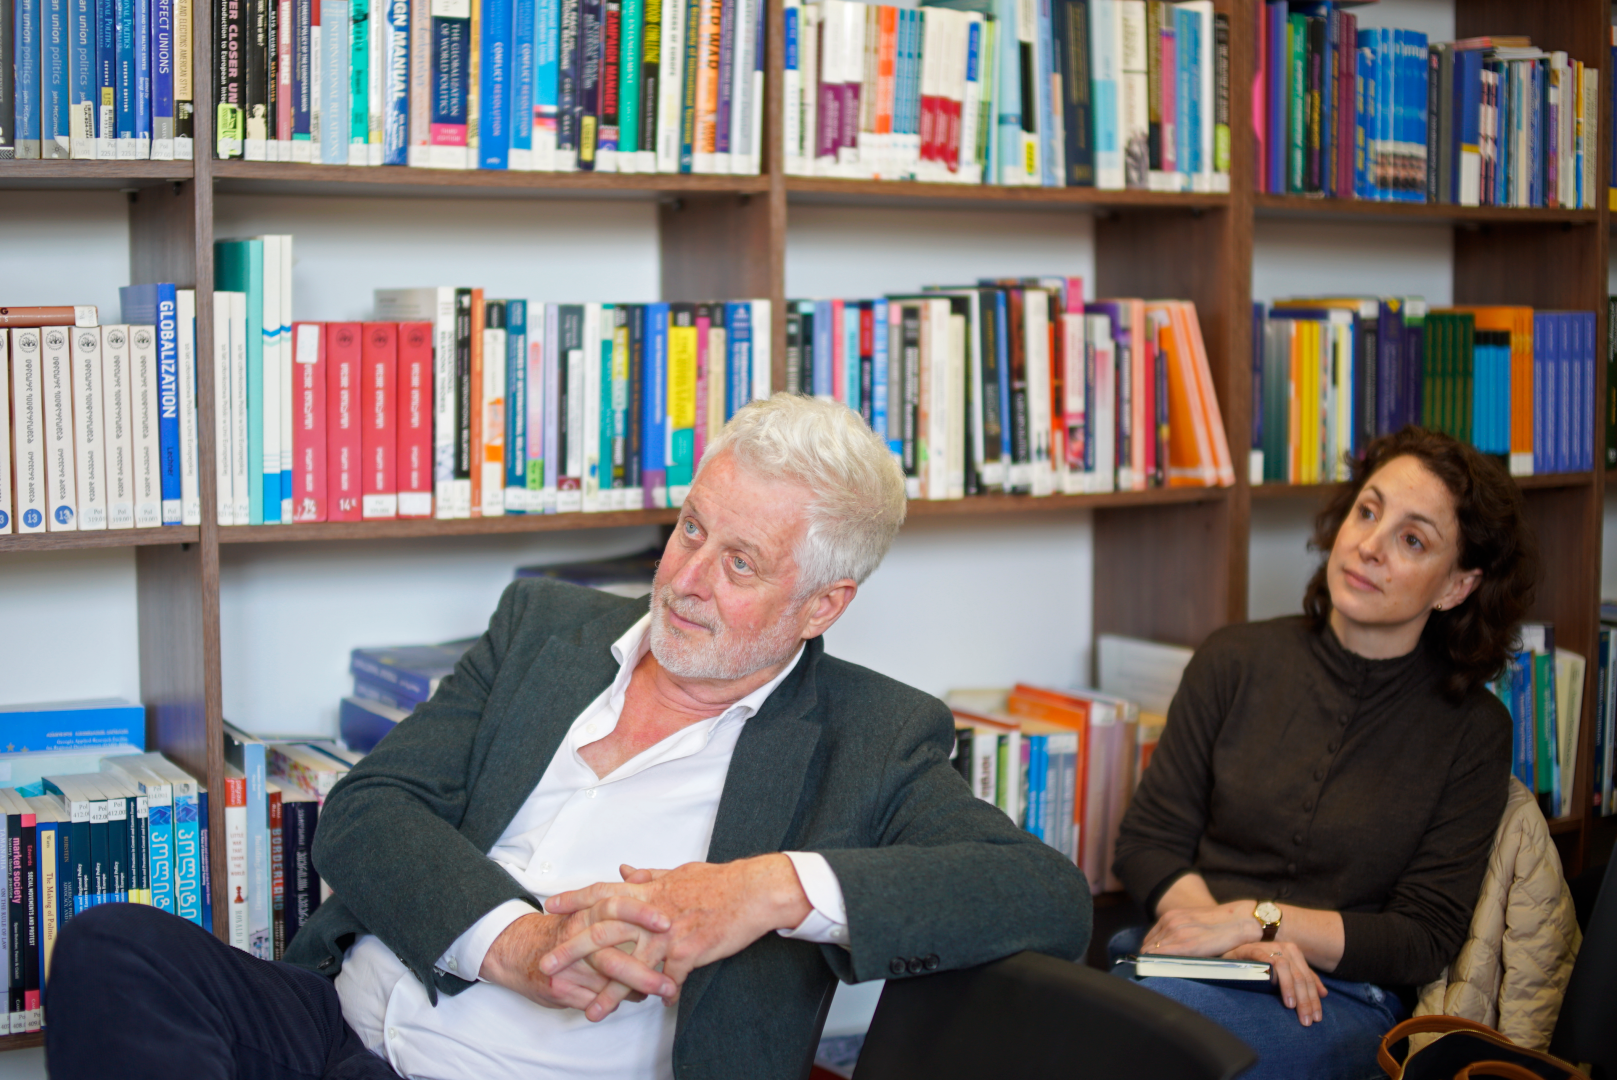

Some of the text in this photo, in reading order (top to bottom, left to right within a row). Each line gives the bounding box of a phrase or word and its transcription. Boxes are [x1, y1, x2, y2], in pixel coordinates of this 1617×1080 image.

[21, 14, 32, 84] union politics
[50, 14, 61, 84] union politics
[78, 16, 88, 85] union politics
[159, 33, 169, 74] UNIONS
[180, 5, 188, 96] AND ELECTIONS AMERICAN STYLE
[219, 40, 228, 85] to European
[228, 25, 238, 78] CLOSER
[281, 2, 290, 85] WINNING PEACE
[394, 32, 407, 102] MANUAL
[440, 24, 450, 115] OF WORLD POLITICS
[450, 24, 460, 116] THE GLOBALIZATION
[605, 11, 620, 114] CAMPAIGN MANAGER
[330, 21, 339, 157] INTERNATIONAL RELATIONS
[492, 42, 504, 136] CONFLICT RESOLUTION
[520, 43, 531, 138] CONFLICT RESOLUTION
[686, 58, 696, 106] International
[160, 301, 176, 418] GLOBALIZATION
[166, 447, 175, 476] Lechner
[28, 514, 37, 522] 13
[2, 888, 6, 898] ON
[12, 837, 22, 904] market society
[45, 886, 54, 908] Making
[272, 828, 283, 910] BORDERLAND
